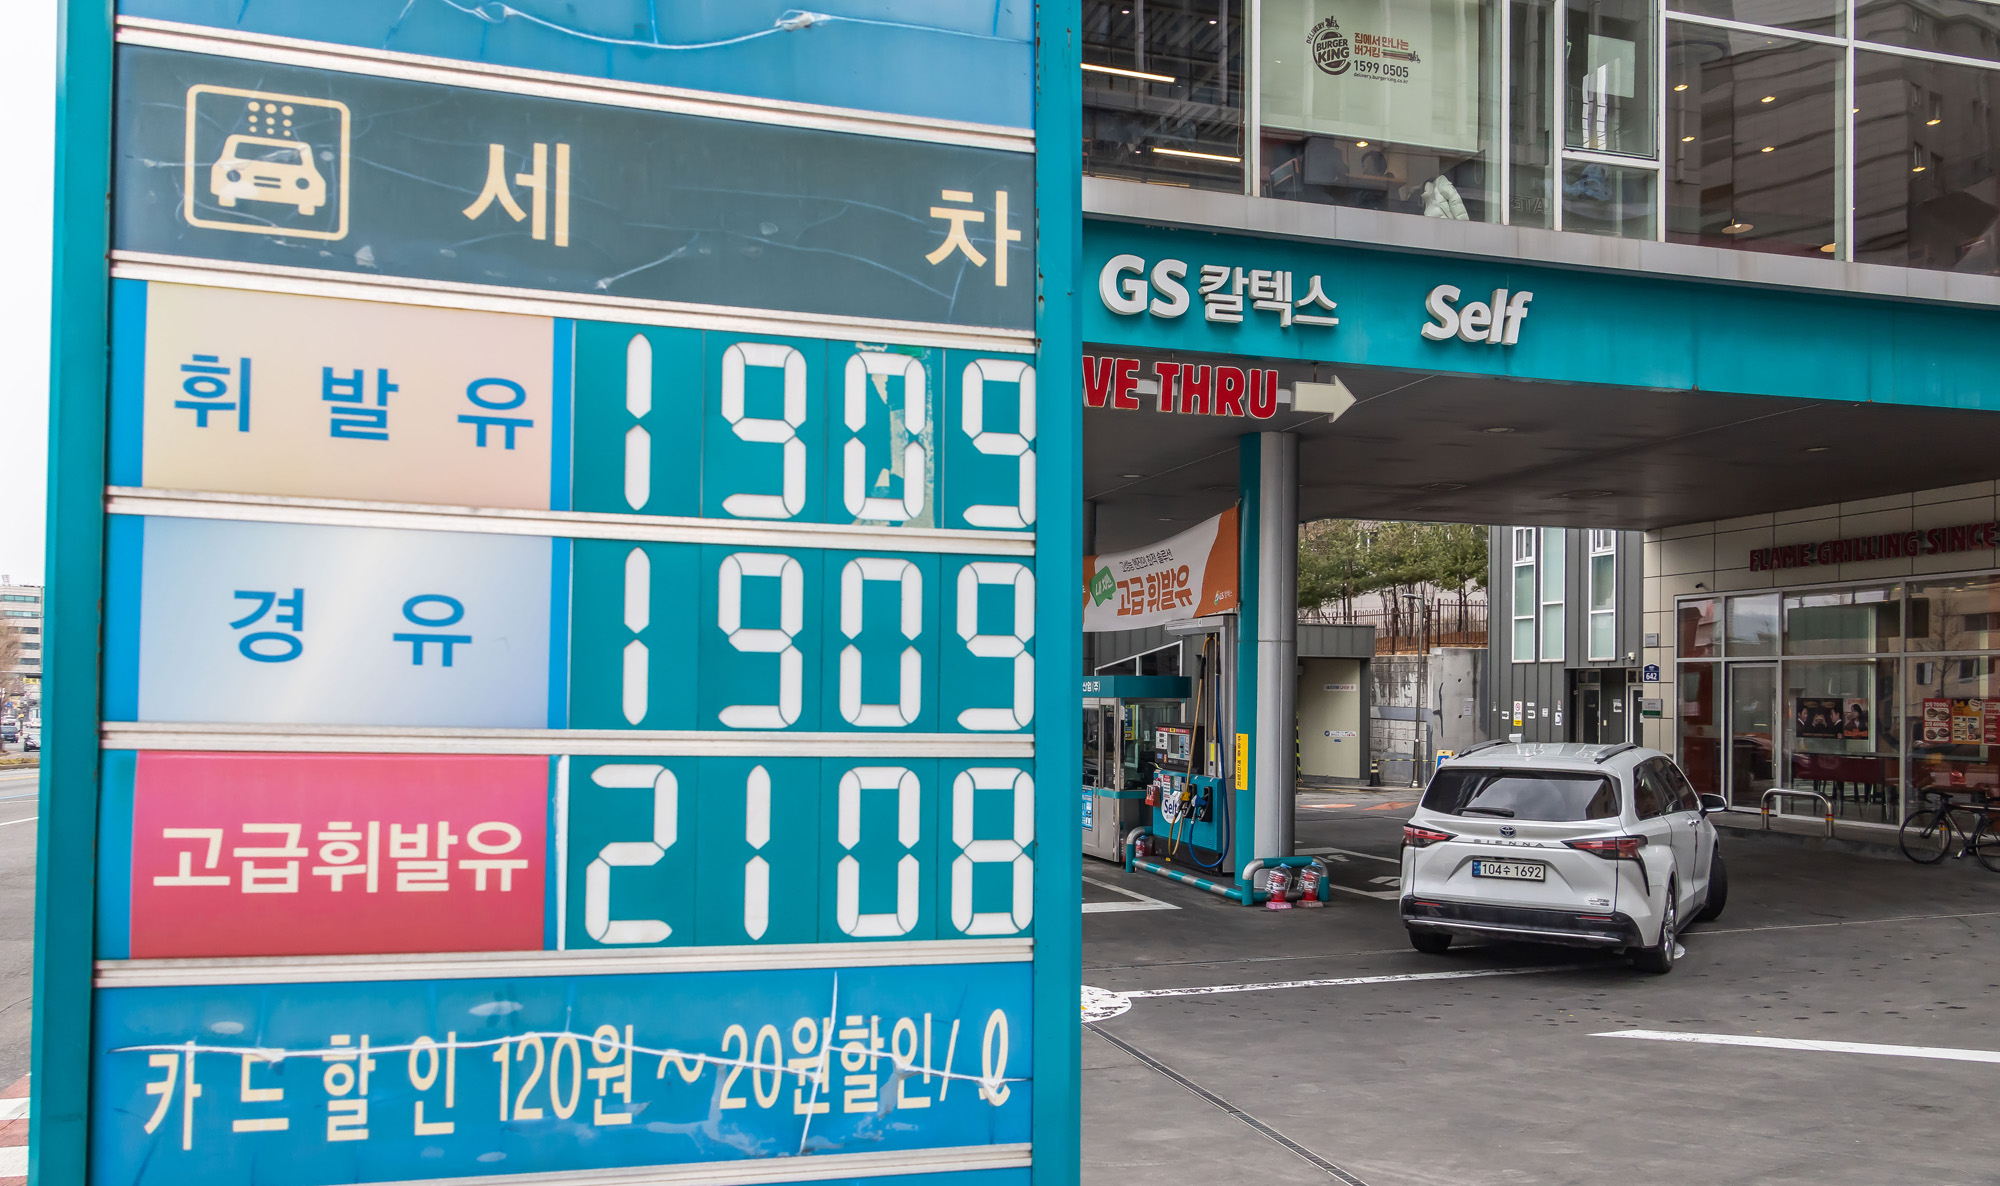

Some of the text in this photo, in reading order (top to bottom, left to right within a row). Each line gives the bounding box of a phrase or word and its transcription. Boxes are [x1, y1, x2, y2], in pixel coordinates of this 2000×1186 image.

[1306, 21, 1325, 44] DELIVERY
[1354, 32, 1409, 51] 집에서 만나는
[1316, 38, 1348, 52] BURGER
[1354, 44, 1381, 58] 버거킹
[1317, 46, 1350, 64] KING
[1354, 60, 1409, 78] 1599 0505
[1420, 283, 1533, 347] Self
[1152, 361, 1279, 420] THRU
[1156, 548, 1174, 564] 솔루션
[1750, 522, 1997, 572] FLAME GRILLING SINCE
[623, 546, 1035, 731] 1909
[1645, 672, 1658, 681] 642
[1473, 839, 1545, 848] SIENNA
[152, 763, 1035, 945] 고급휘발유 2108
[1482, 863, 1542, 878] 104수 1692
